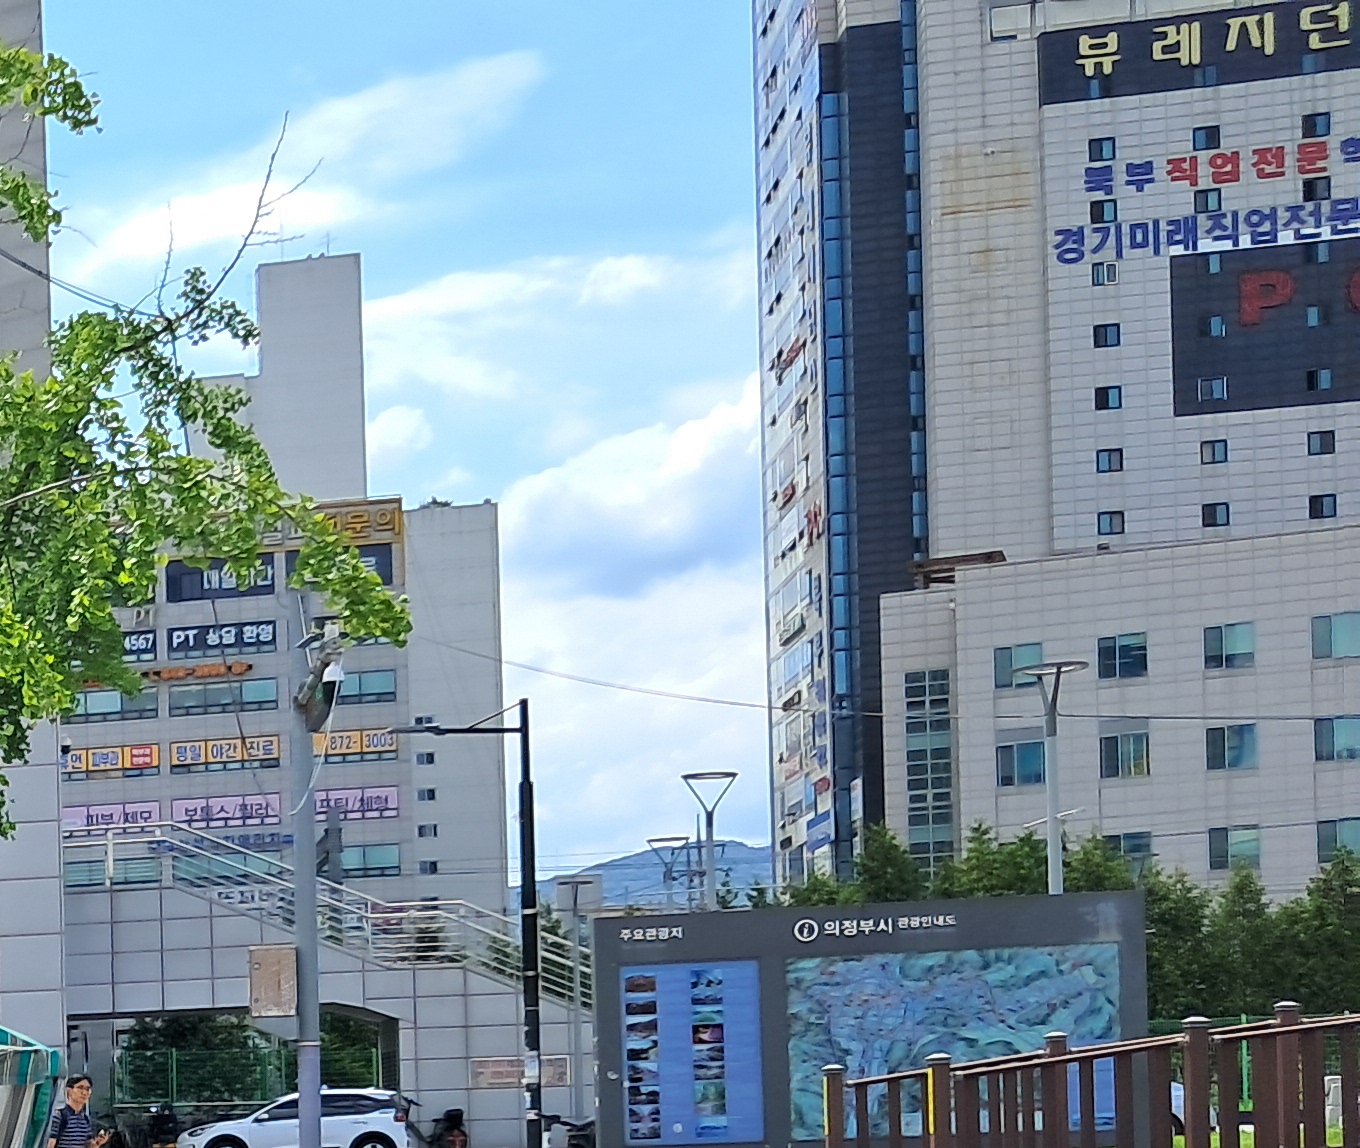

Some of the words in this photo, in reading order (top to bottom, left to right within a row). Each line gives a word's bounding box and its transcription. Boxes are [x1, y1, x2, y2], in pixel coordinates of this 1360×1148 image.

[172, 629, 200, 648] PT
[205, 627, 237, 646] 상담
[242, 622, 274, 643] 환영
[176, 743, 202, 762] 평일
[211, 742, 238, 760] 야간
[247, 740, 275, 758] 진료
[619, 926, 684, 942] 주요관광지
[823, 917, 893, 937] 의정부시
